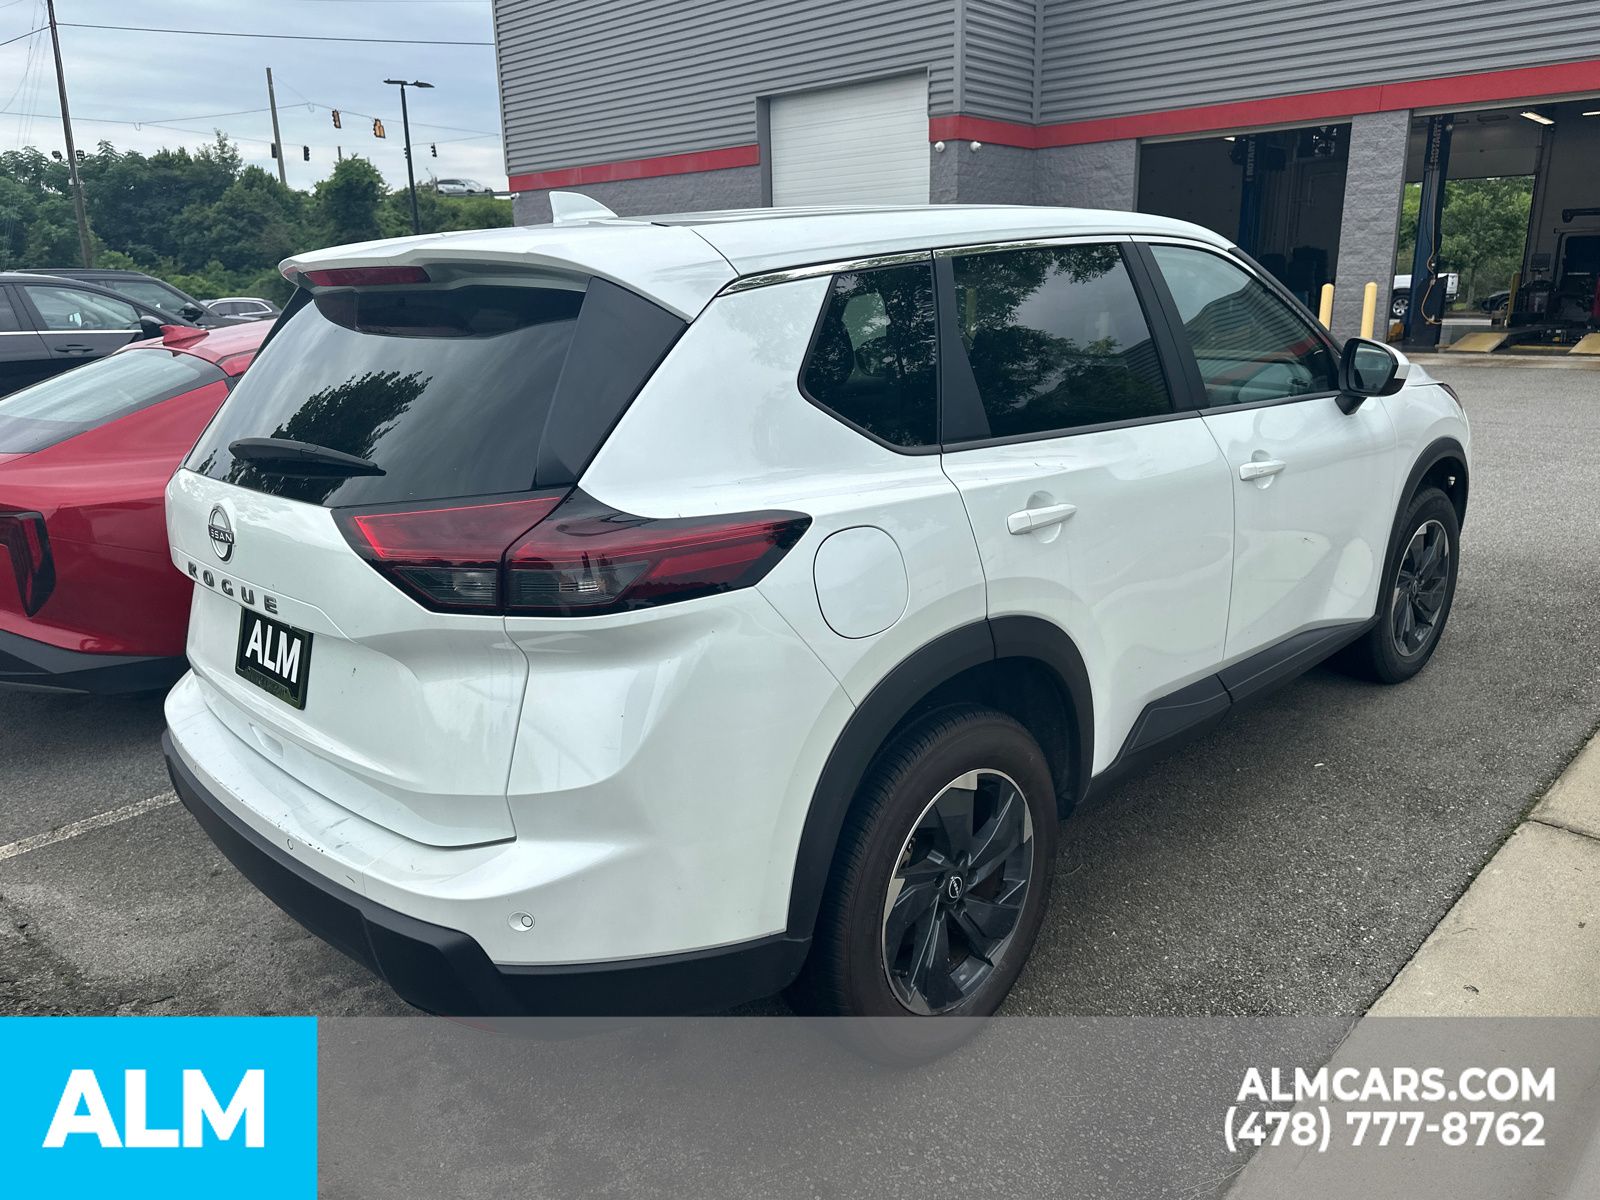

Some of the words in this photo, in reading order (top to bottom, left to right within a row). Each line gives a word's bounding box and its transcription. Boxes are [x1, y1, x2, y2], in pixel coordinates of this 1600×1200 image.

[1246, 141, 1255, 176] ROTARY
[187, 561, 278, 614] ROGUE
[245, 619, 302, 683] ALM
